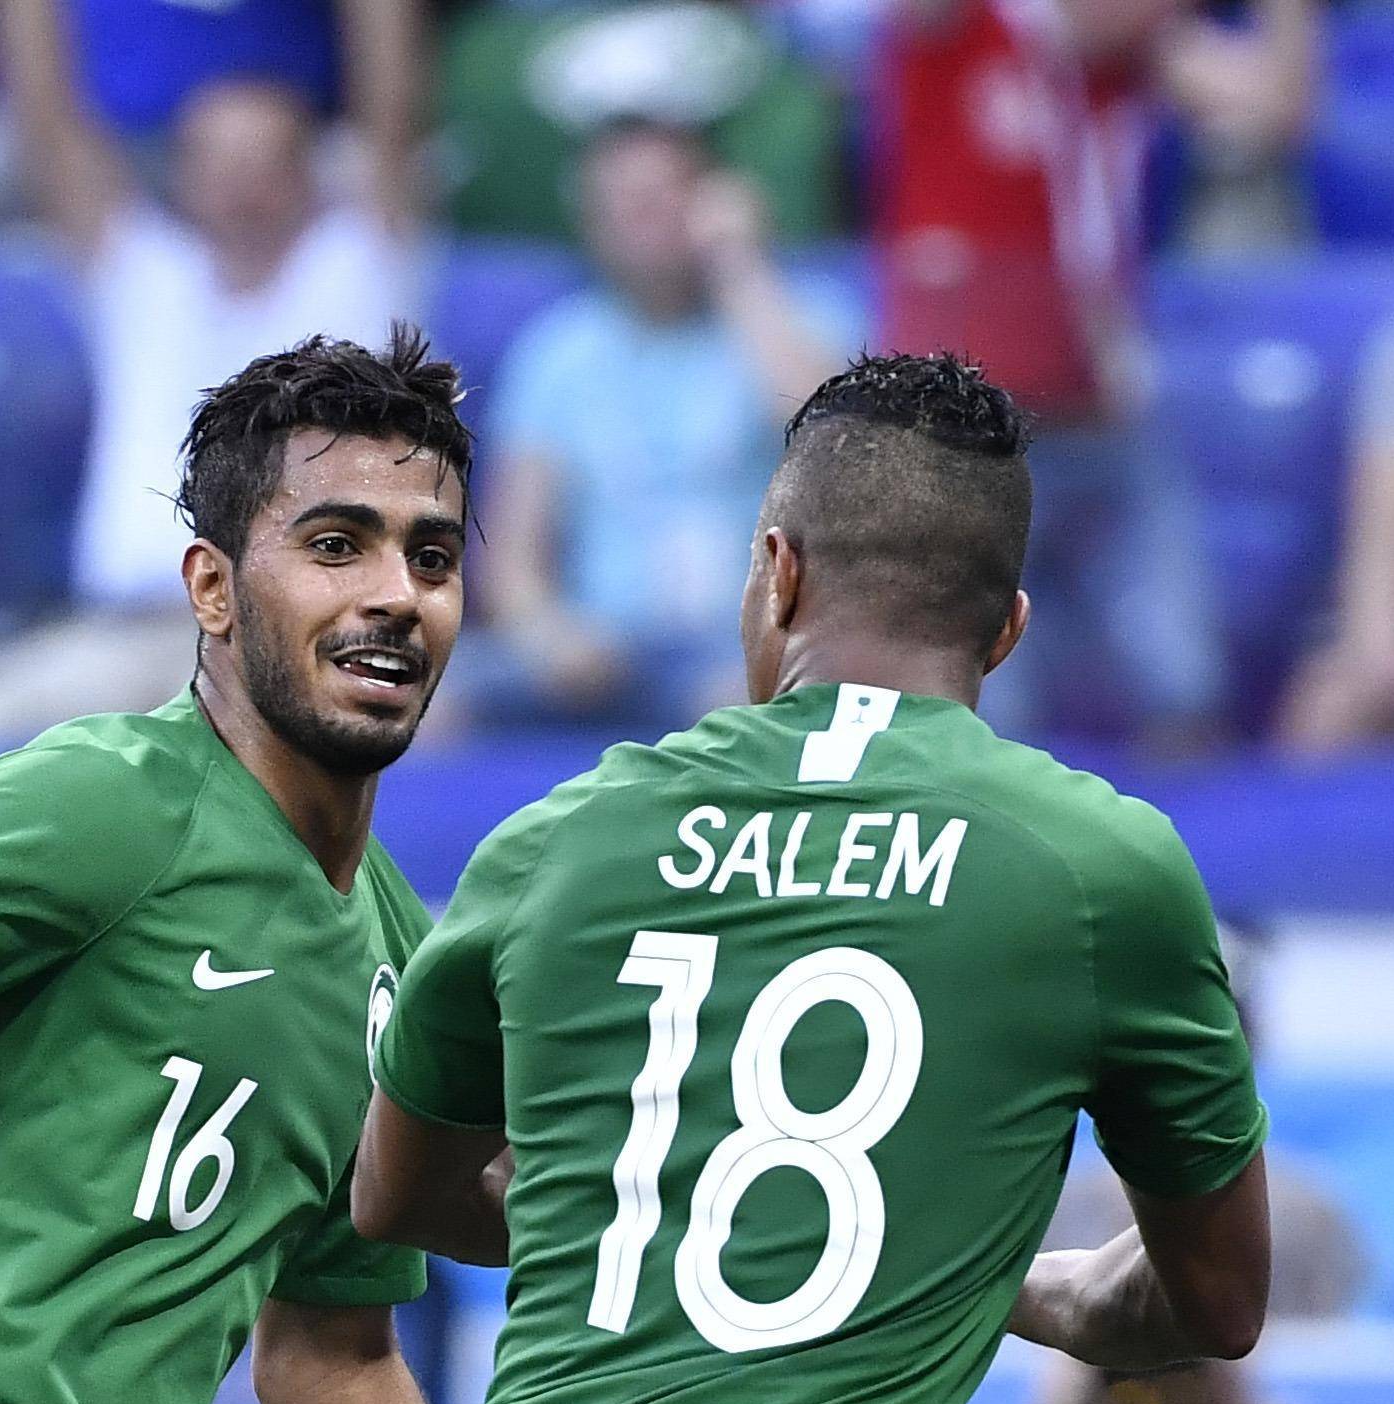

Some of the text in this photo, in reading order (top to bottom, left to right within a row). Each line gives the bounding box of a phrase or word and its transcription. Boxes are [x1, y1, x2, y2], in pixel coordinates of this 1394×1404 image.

[657, 805, 968, 907] SALEM
[132, 1055, 259, 1231] 16
[586, 930, 924, 1354] 18
